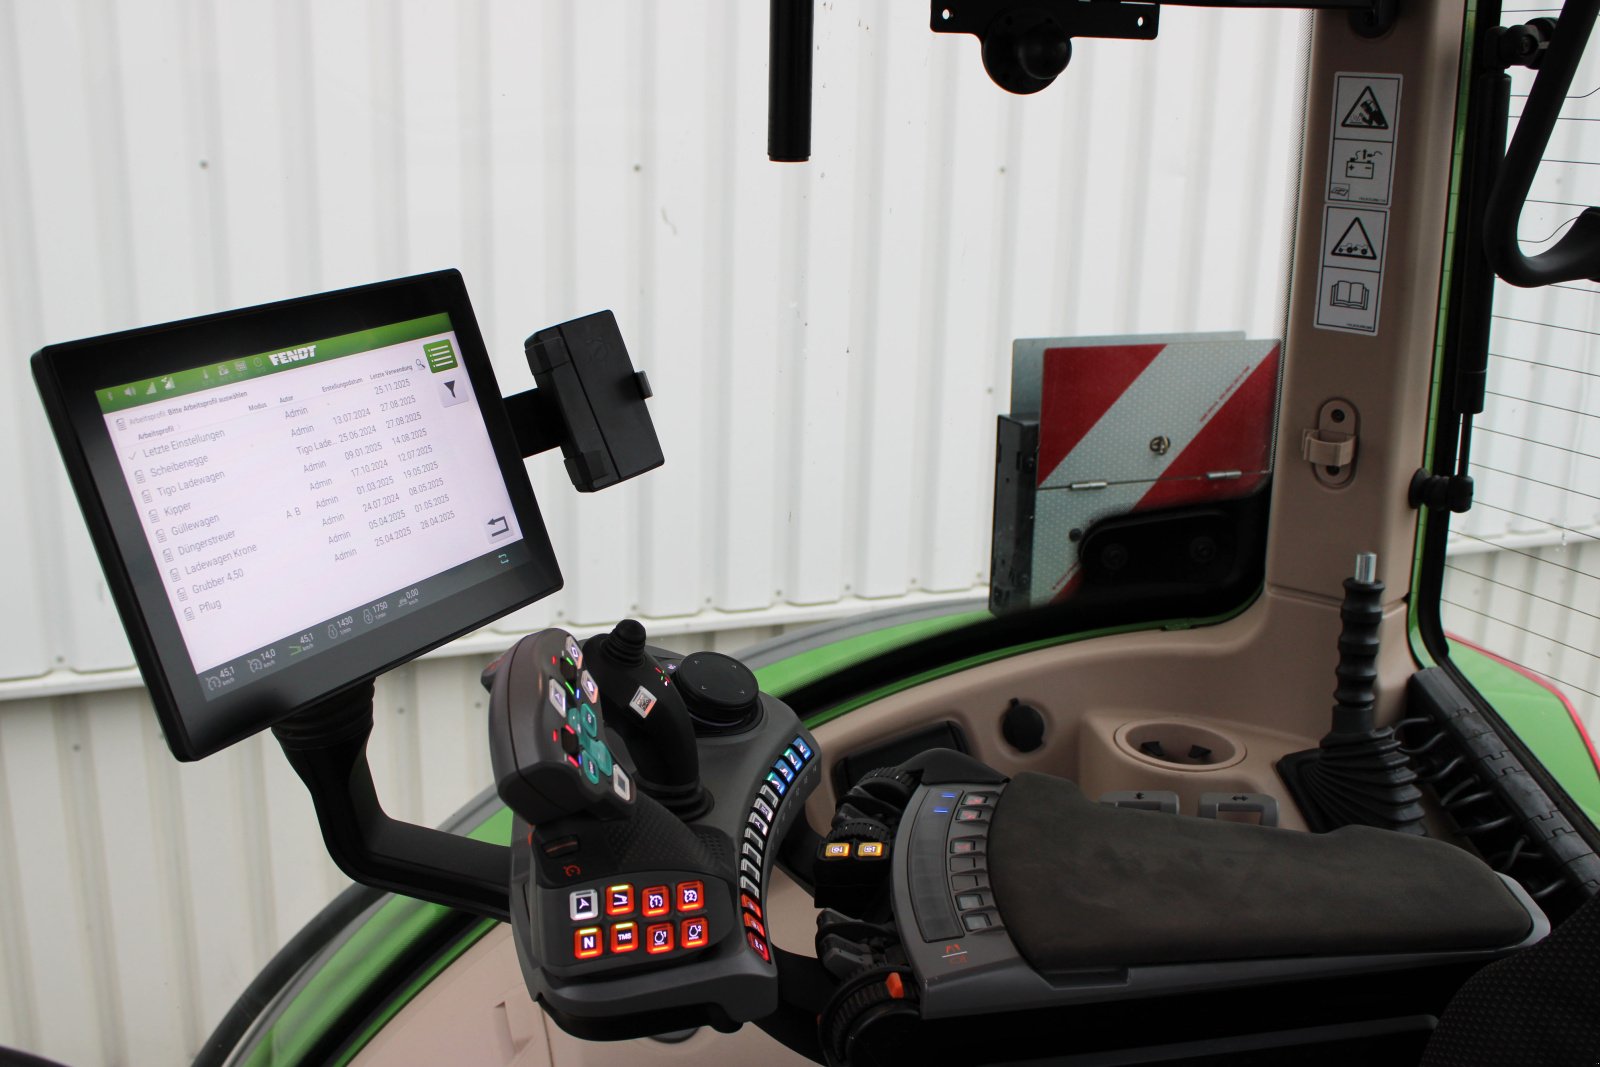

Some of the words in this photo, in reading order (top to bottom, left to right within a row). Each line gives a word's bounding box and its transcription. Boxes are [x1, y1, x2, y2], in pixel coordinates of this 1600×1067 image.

[269, 345, 317, 366] FENDT
[370, 370, 384, 380] Letzte
[384, 364, 413, 376] Verwendung
[322, 377, 364, 393] Erstellungsdatum
[374, 378, 411, 395] 25.11.2025
[168, 407, 182, 416] Bitte
[184, 398, 218, 412] Arbeitsprofil
[219, 391, 248, 404] auswählen
[248, 402, 267, 411] Modus
[279, 395, 294, 403] Autor
[380, 395, 416, 412] 27.08.2025
[285, 407, 308, 420] Admin
[332, 408, 371, 425] 13.07.2024
[386, 412, 422, 429] 27.08.2025
[138, 426, 175, 440] Arbeitsprofil
[291, 424, 314, 438] Admin
[338, 425, 376, 443] 25.06.2024
[392, 428, 428, 446] 14.08.2025
[142, 442, 170, 458] Letzte
[171, 429, 226, 450] Einstellungen
[296, 444, 313, 456] Tigo
[344, 442, 383, 460] 09.01.2025
[398, 445, 433, 462] 12.07.2025
[150, 454, 208, 478] Scheibenegge
[303, 460, 327, 473] Admin
[351, 460, 388, 478] 17.10.2024
[404, 461, 439, 479] 19.05.2025
[157, 484, 178, 497] Tigo
[178, 470, 226, 491] Ladewagen
[310, 477, 332, 491] Admin
[356, 476, 394, 495] 01.03.2025
[408, 478, 444, 496] 08.05.2025
[164, 502, 192, 516] Kipper
[316, 495, 339, 509] Admin
[362, 493, 400, 512] 24.07.2024
[414, 494, 450, 513] 01.05.2025
[286, 510, 292, 519] A
[294, 507, 301, 516] B
[322, 512, 345, 526] Admin
[368, 510, 406, 530] 05.04.2025
[420, 510, 455, 530] 28.04.2025
[172, 514, 220, 536] Güllewagen
[178, 530, 235, 556] Düngerstreuer
[328, 530, 351, 544] Admin
[374, 527, 412, 547] 25.04.2025
[185, 553, 233, 574] Ladewagen
[233, 544, 258, 558] Krone
[334, 548, 357, 562] Admin
[192, 576, 224, 594] Grubber
[227, 568, 244, 582] 4,50
[406, 588, 419, 600] 0,00
[198, 600, 222, 613] Pflug
[372, 601, 388, 613] 1750
[337, 616, 354, 628] 1430
[300, 632, 314, 646] 45,1
[260, 648, 276, 661] 14,0
[220, 666, 235, 679] 45,1
[584, 936, 594, 949] N
[618, 932, 632, 941] TMS
